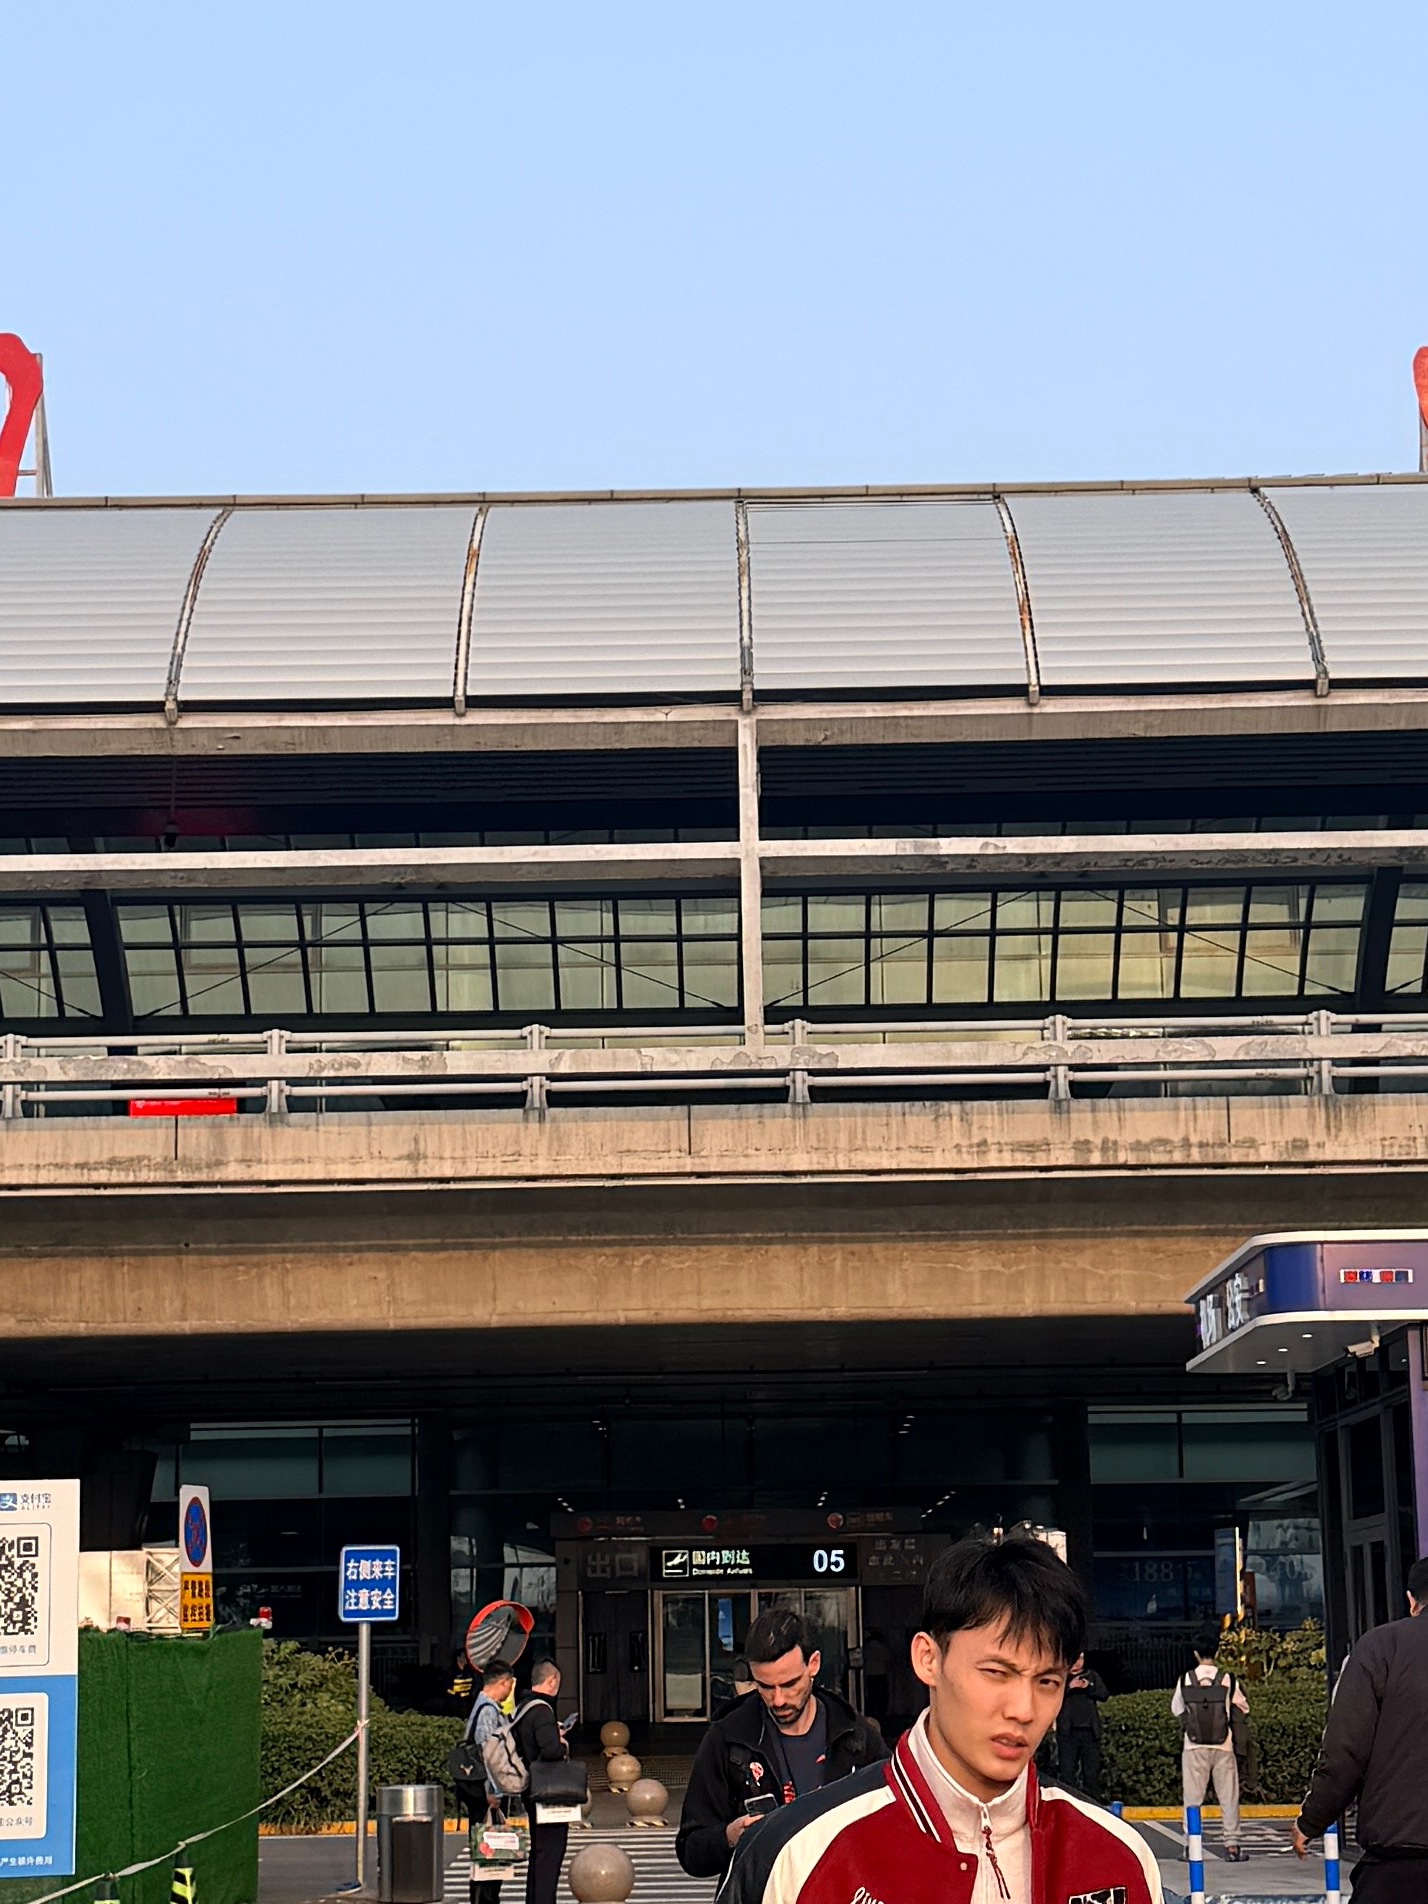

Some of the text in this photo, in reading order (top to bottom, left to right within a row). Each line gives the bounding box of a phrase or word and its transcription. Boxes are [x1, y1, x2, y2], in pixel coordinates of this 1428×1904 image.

[346, 1558, 395, 1580] 右侧来车
[692, 1549, 750, 1565] 国内到达
[813, 1549, 845, 1573] 05
[345, 1588, 395, 1610] 注意安全
